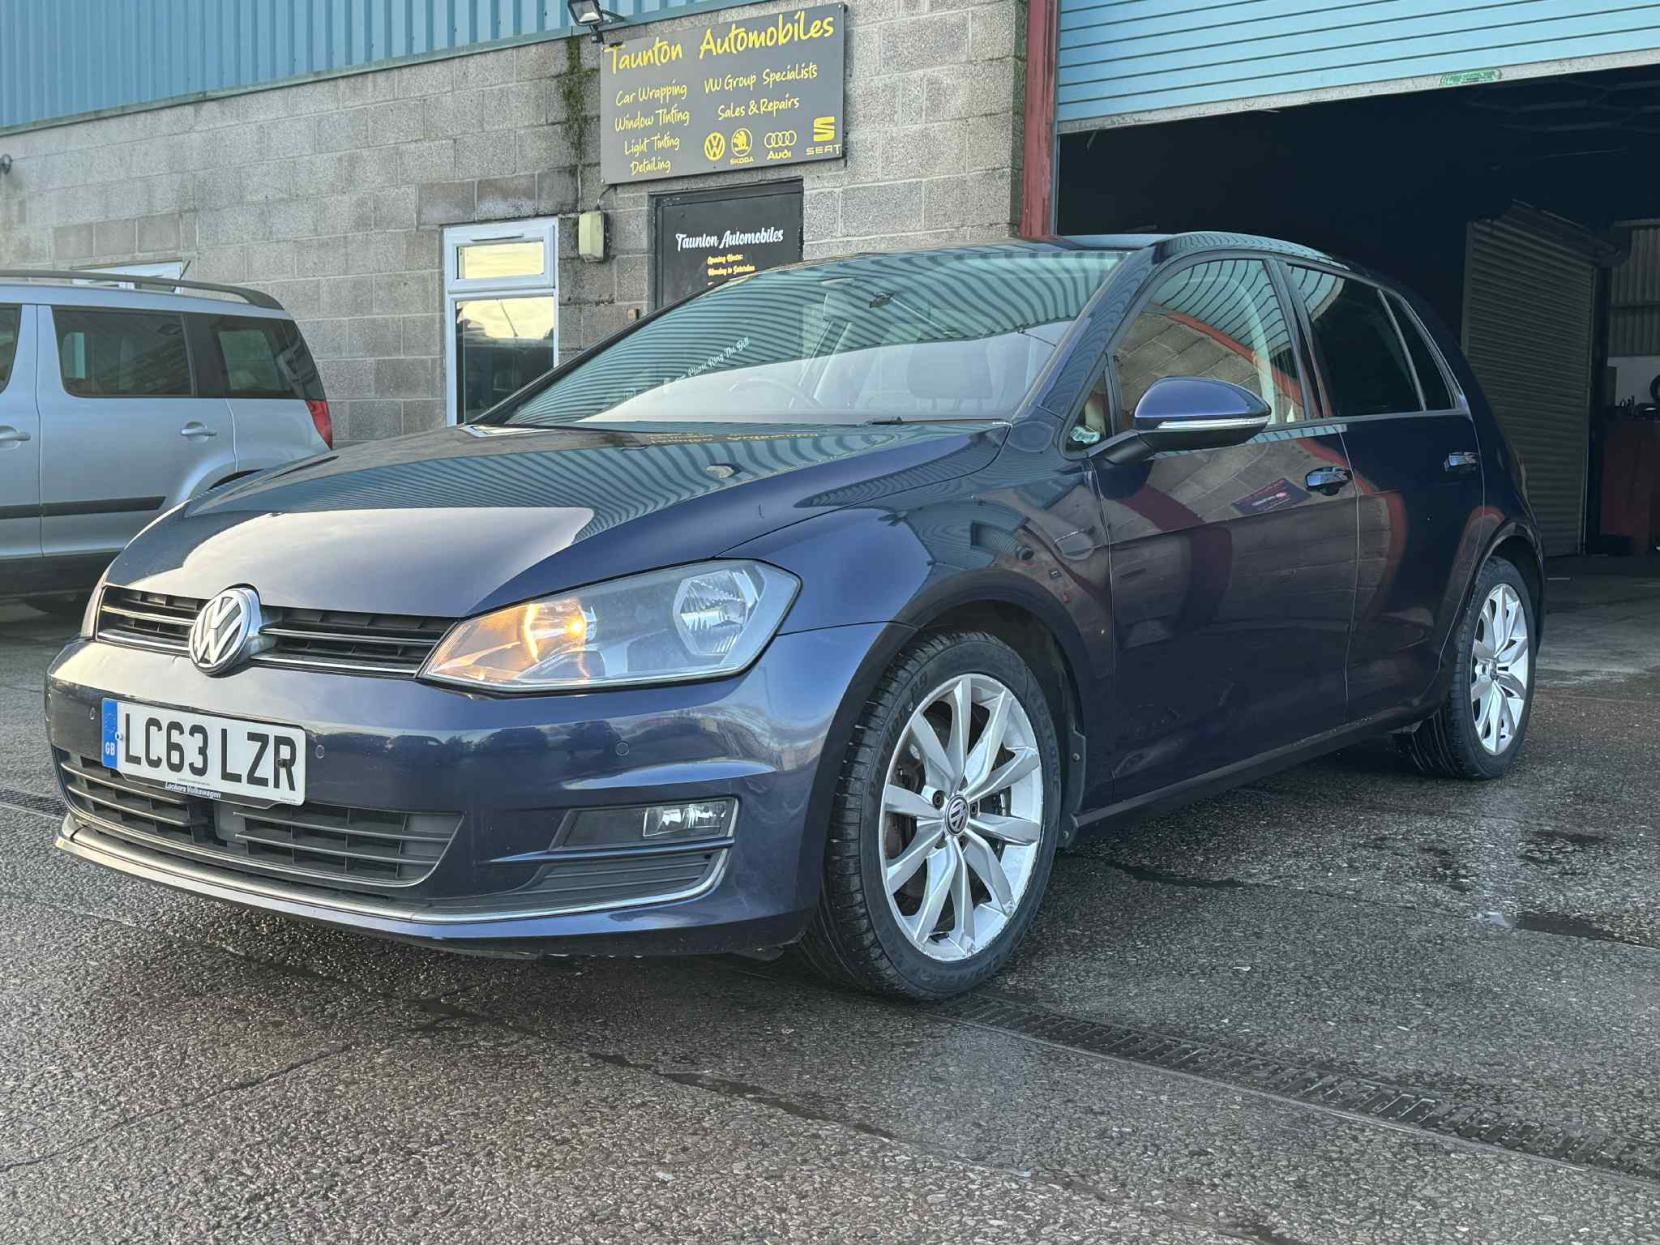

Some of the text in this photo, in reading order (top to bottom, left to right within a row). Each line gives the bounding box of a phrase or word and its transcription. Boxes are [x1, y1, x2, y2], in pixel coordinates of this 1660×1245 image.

[604, 11, 835, 75] Taunton Automobiles
[704, 62, 818, 94] VW Group Specialists
[615, 79, 688, 106] Car Wrapping
[614, 104, 690, 132] Window Tinting
[718, 93, 800, 121] Sales & Repairs
[624, 131, 680, 157] Light Tinting
[806, 144, 842, 155] SEAT
[630, 157, 671, 176] Detailing
[675, 227, 784, 252] Taunton Automobiles
[707, 267, 728, 276] Monday
[105, 741, 116, 757] GB
[125, 712, 297, 792] LC63 LZR
